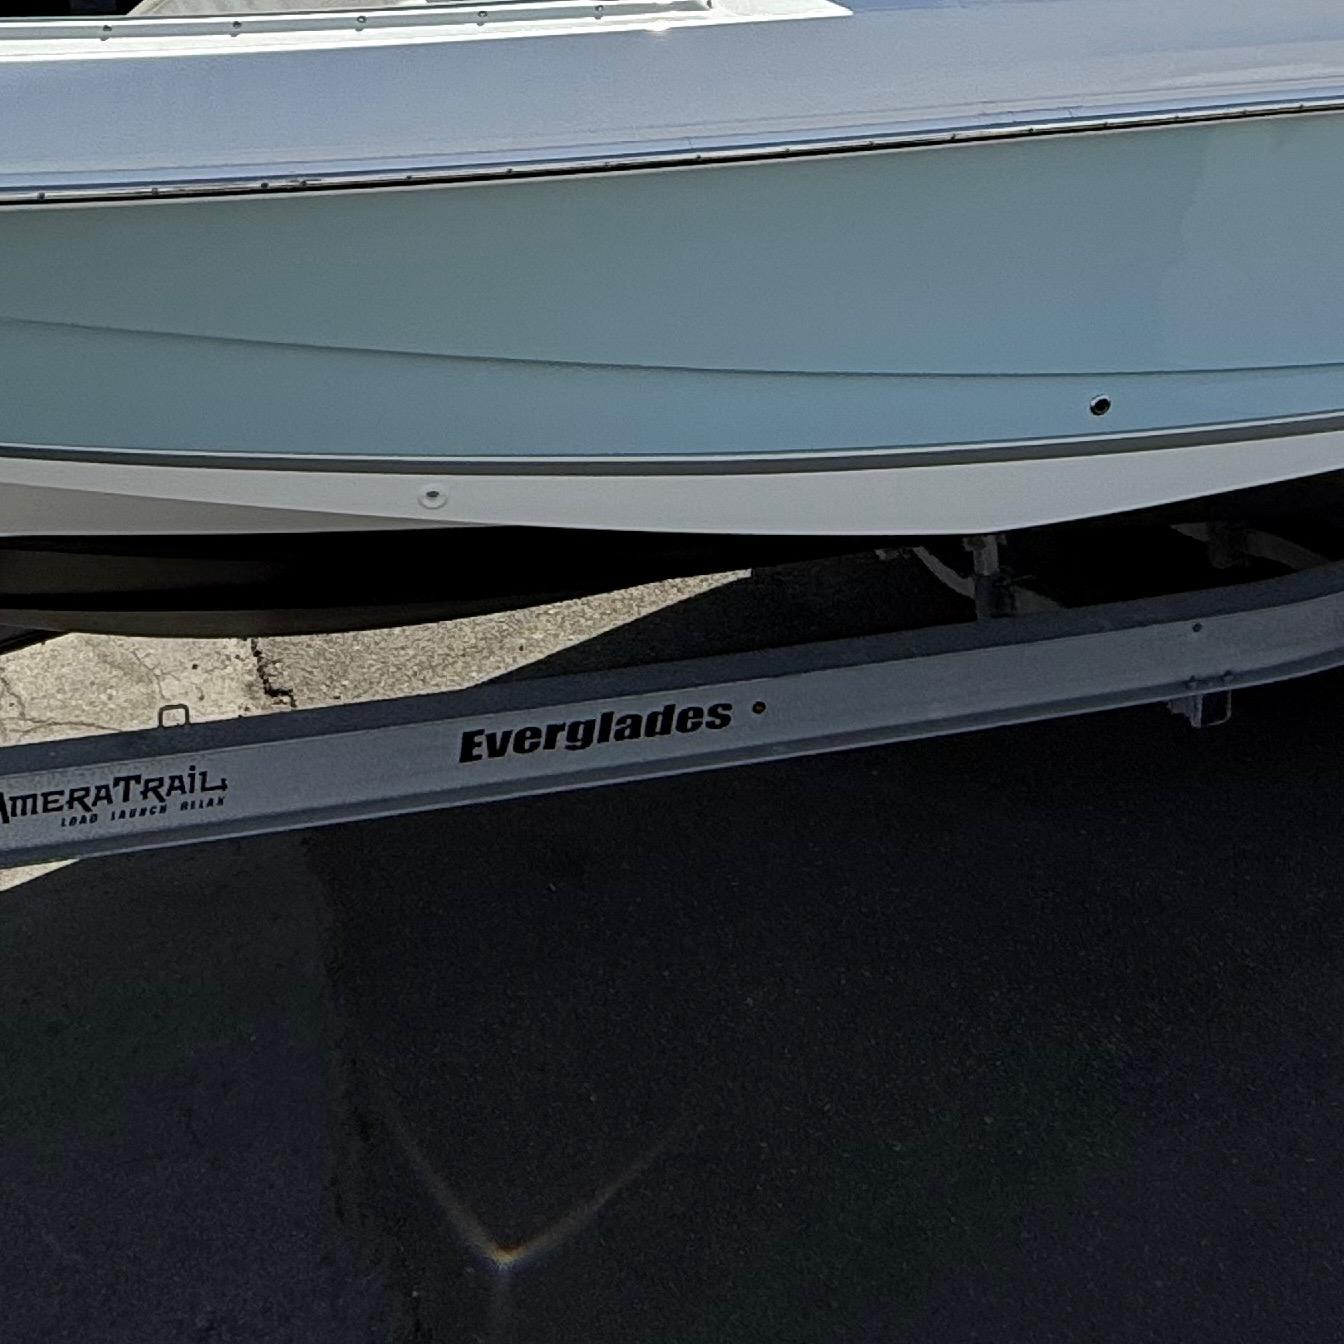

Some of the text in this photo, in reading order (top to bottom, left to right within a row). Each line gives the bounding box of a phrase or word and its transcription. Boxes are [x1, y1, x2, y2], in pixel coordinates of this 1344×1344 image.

[459, 702, 733, 763] Everglades
[61, 796, 226, 827] LOAD LAUNCH RELAX
